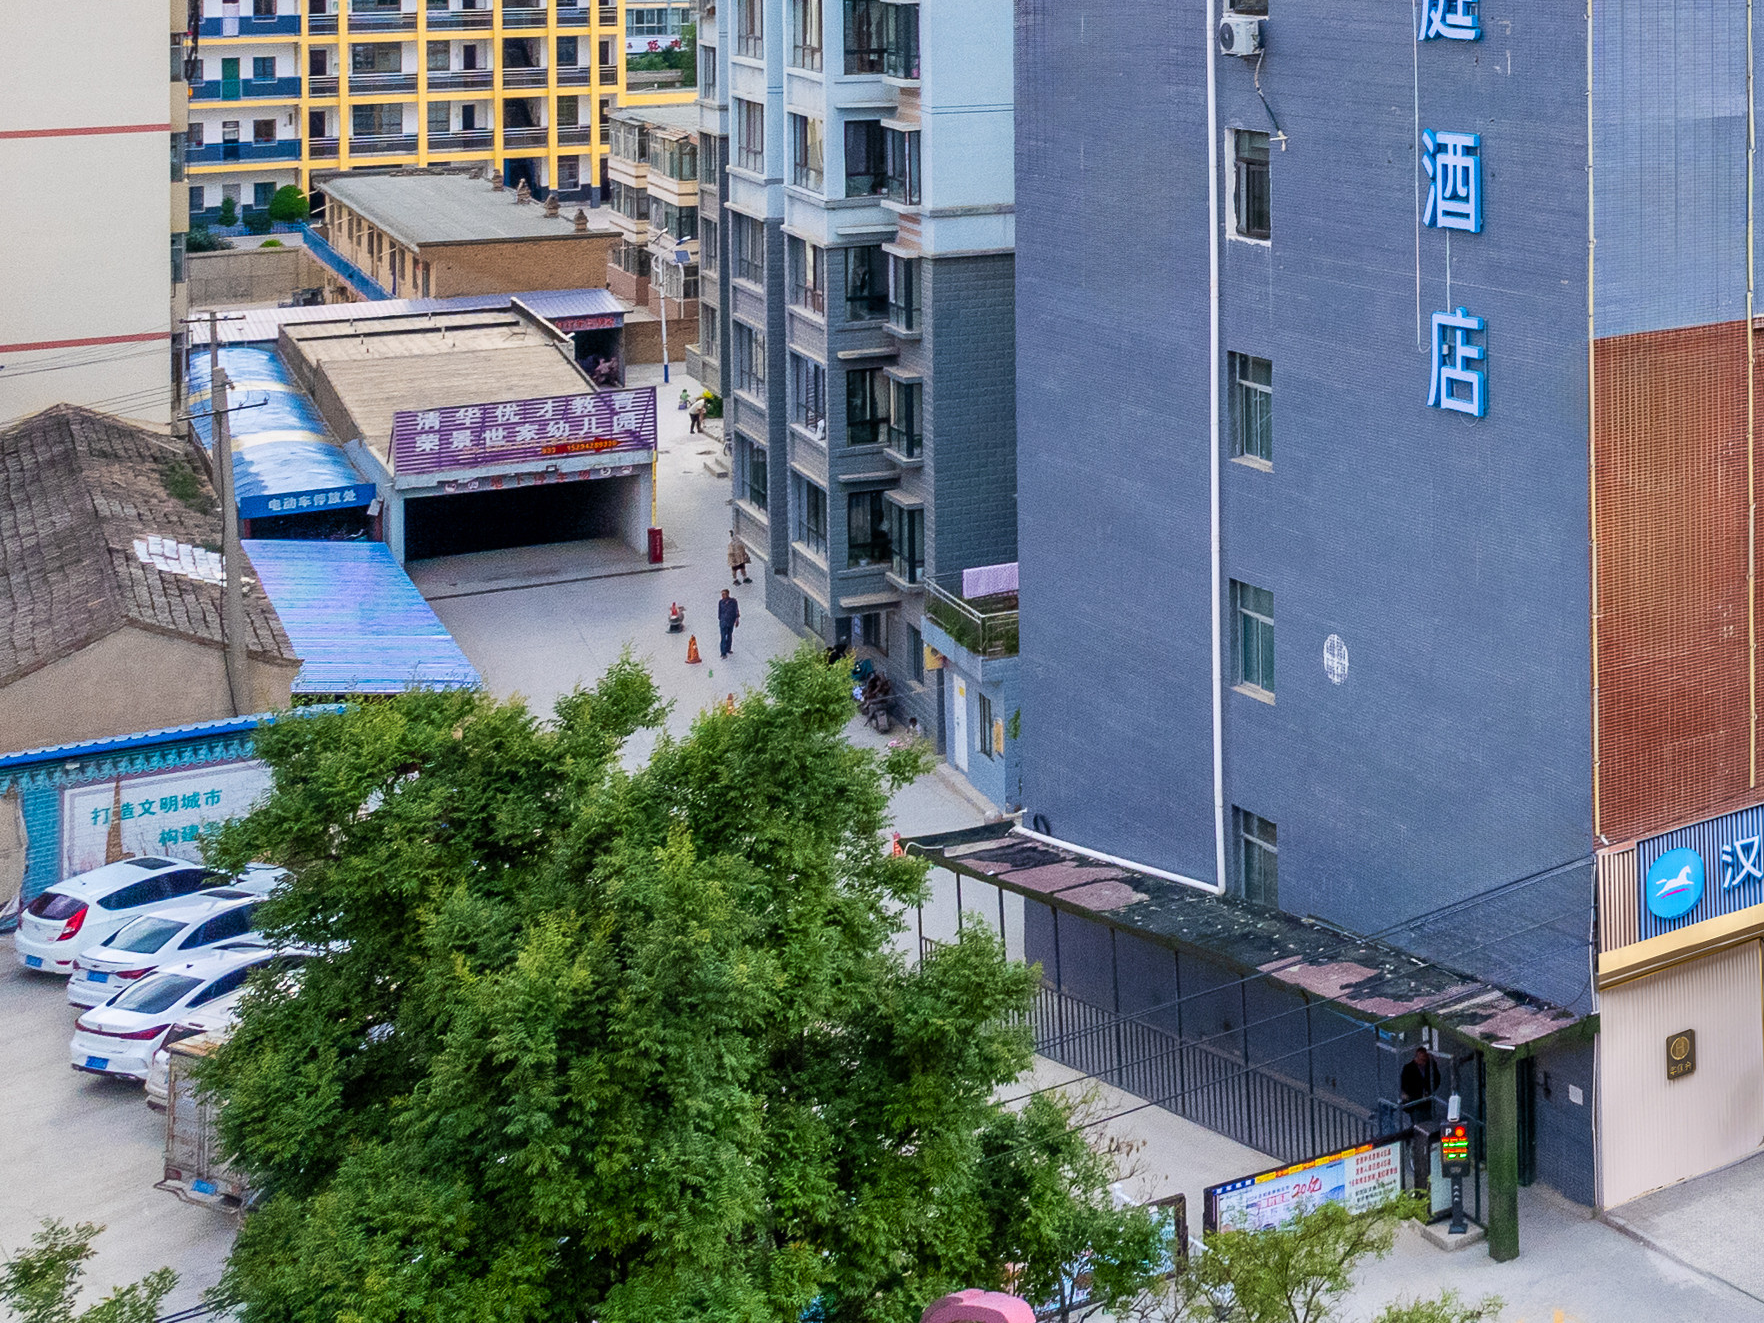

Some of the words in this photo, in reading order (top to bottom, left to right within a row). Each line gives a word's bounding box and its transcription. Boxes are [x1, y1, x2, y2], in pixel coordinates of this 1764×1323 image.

[415, 391, 636, 431] 清华优才教育
[415, 412, 637, 453] 荣景世家幼儿园
[268, 488, 357, 511] 电动车停放处
[90, 788, 223, 826] 打造文明城市
[1445, 1127, 1452, 1136] P
[1291, 1175, 1322, 1199] 20亿
